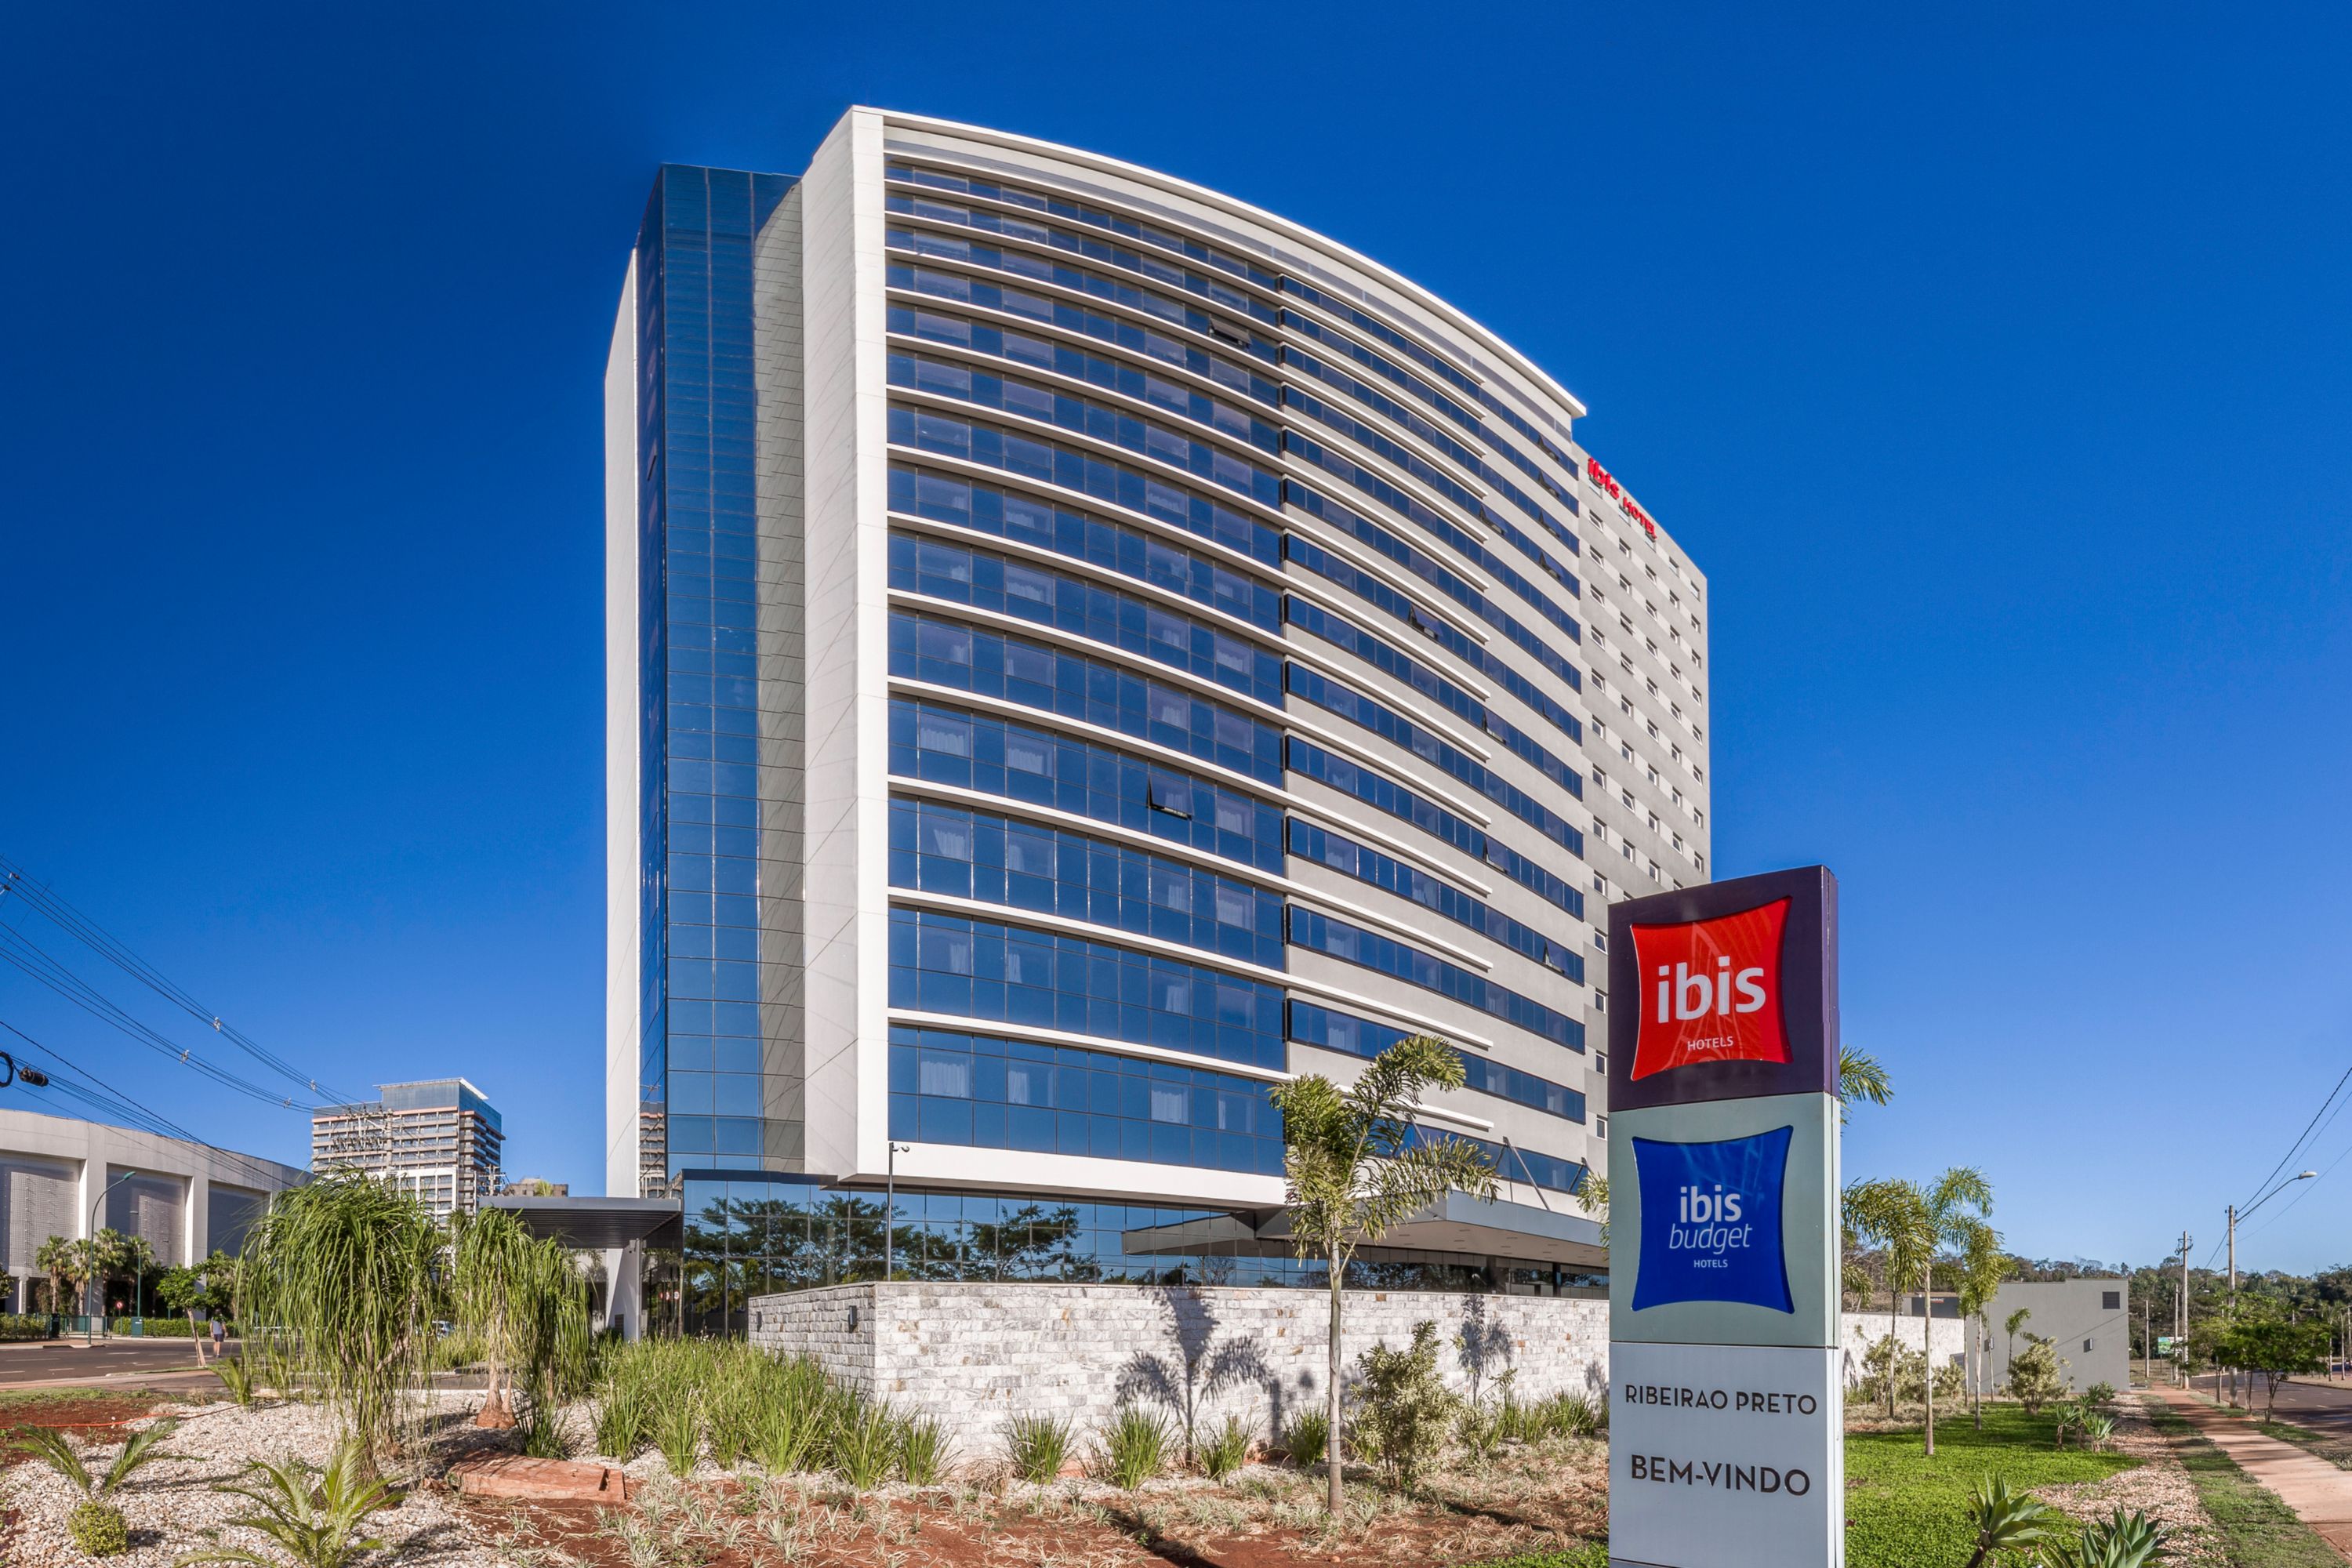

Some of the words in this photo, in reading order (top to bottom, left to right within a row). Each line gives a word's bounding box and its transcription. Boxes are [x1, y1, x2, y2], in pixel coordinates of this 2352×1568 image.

[1588, 457, 1619, 499] ibis
[1657, 956, 1766, 1024] ibis
[1687, 1036, 1734, 1051] HOTELS
[1680, 1185, 1742, 1223] ibis
[1669, 1221, 1752, 1254] budget
[1693, 1259, 1728, 1268] HOTELS
[1625, 1385, 1728, 1410] RIBEIRAO
[1736, 1392, 1817, 1415] PRETO
[1632, 1454, 1810, 1496] BEM-VINDO
